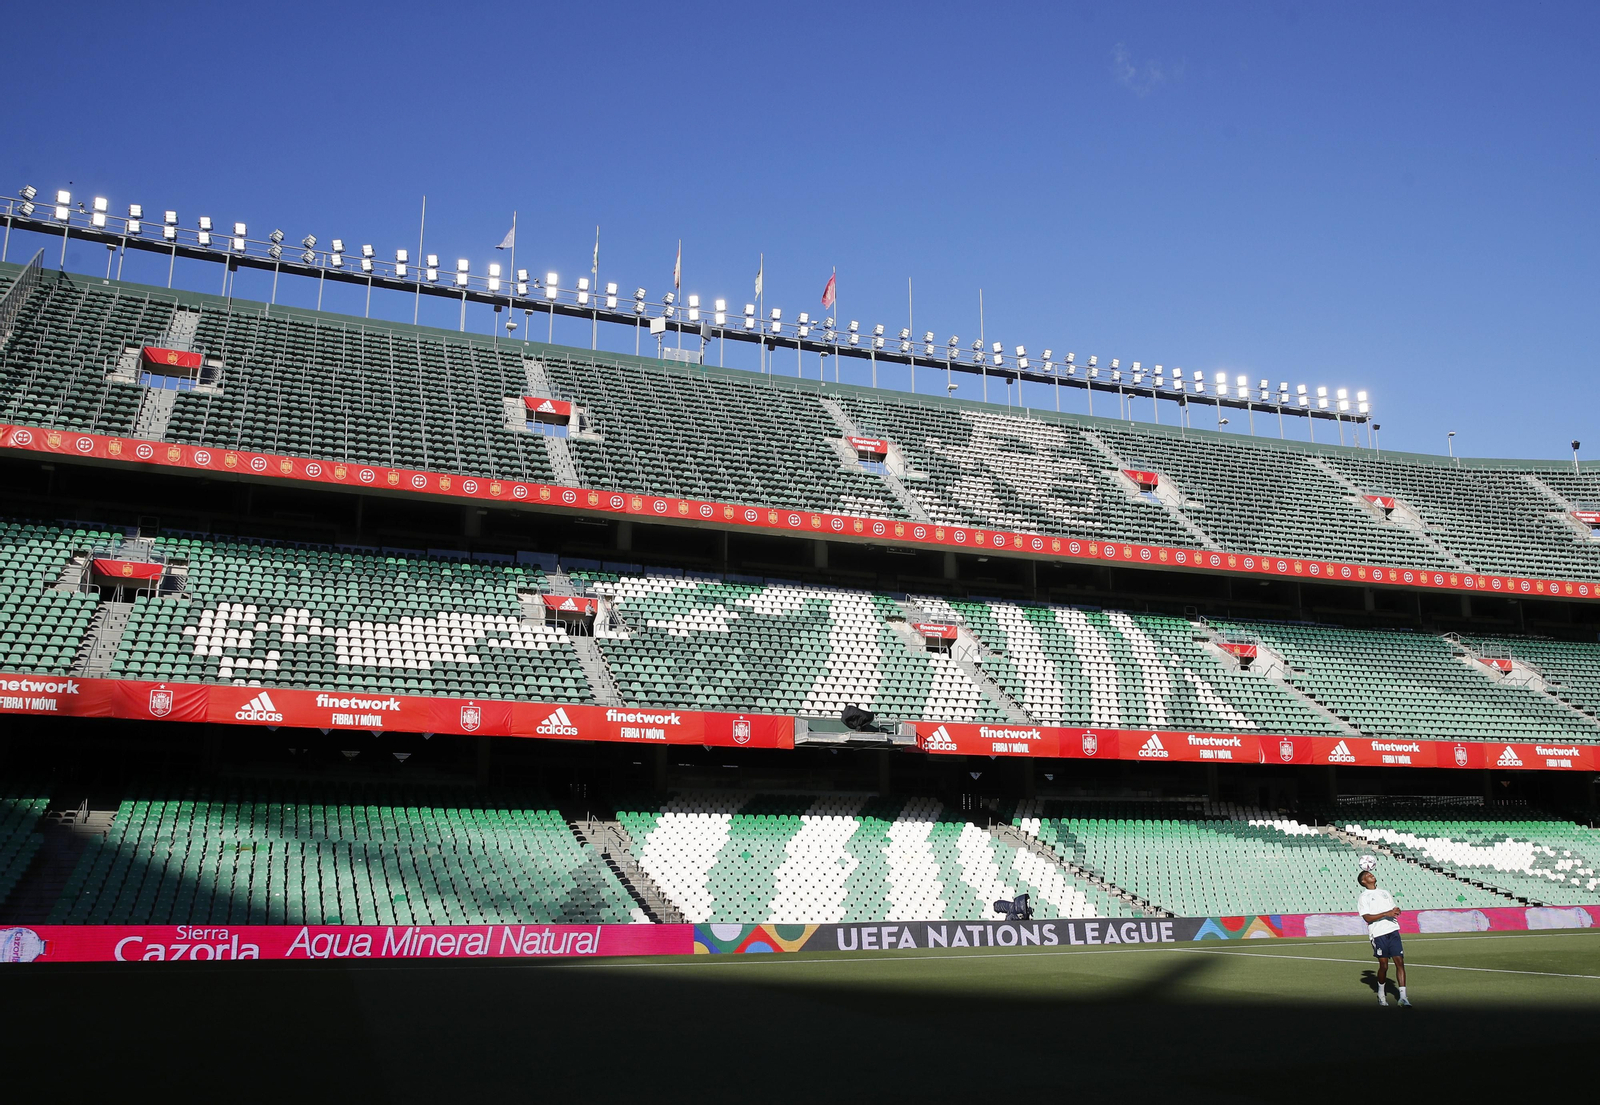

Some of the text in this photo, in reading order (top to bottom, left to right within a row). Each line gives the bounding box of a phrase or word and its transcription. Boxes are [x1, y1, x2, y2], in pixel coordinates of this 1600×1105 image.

[25, 697, 32, 710] Y
[31, 696, 58, 711] MÓVIL
[316, 694, 401, 711] finetwork
[235, 708, 283, 722] adidas
[332, 713, 383, 727] FIBRA Y MÓVIL
[606, 709, 681, 726] finetwork
[536, 724, 579, 736] adidas
[620, 727, 666, 740] FIBRA Y MÓVIL
[979, 726, 1042, 740] finetwork
[922, 739, 958, 751] adidas
[1187, 735, 1242, 747] finetwork
[1371, 740, 1421, 753] finetwork
[1138, 748, 1169, 758] adidas
[1327, 753, 1356, 763] adidas
[1535, 745, 1580, 757] finetwork
[1496, 759, 1523, 767] adidas
[175, 925, 229, 940] Sierra
[836, 921, 1176, 951] UEFA NATIONS LEAGUE
[381, 926, 492, 957] Mineral
[499, 924, 602, 955] Natural
[114, 934, 260, 962] Cazorla
